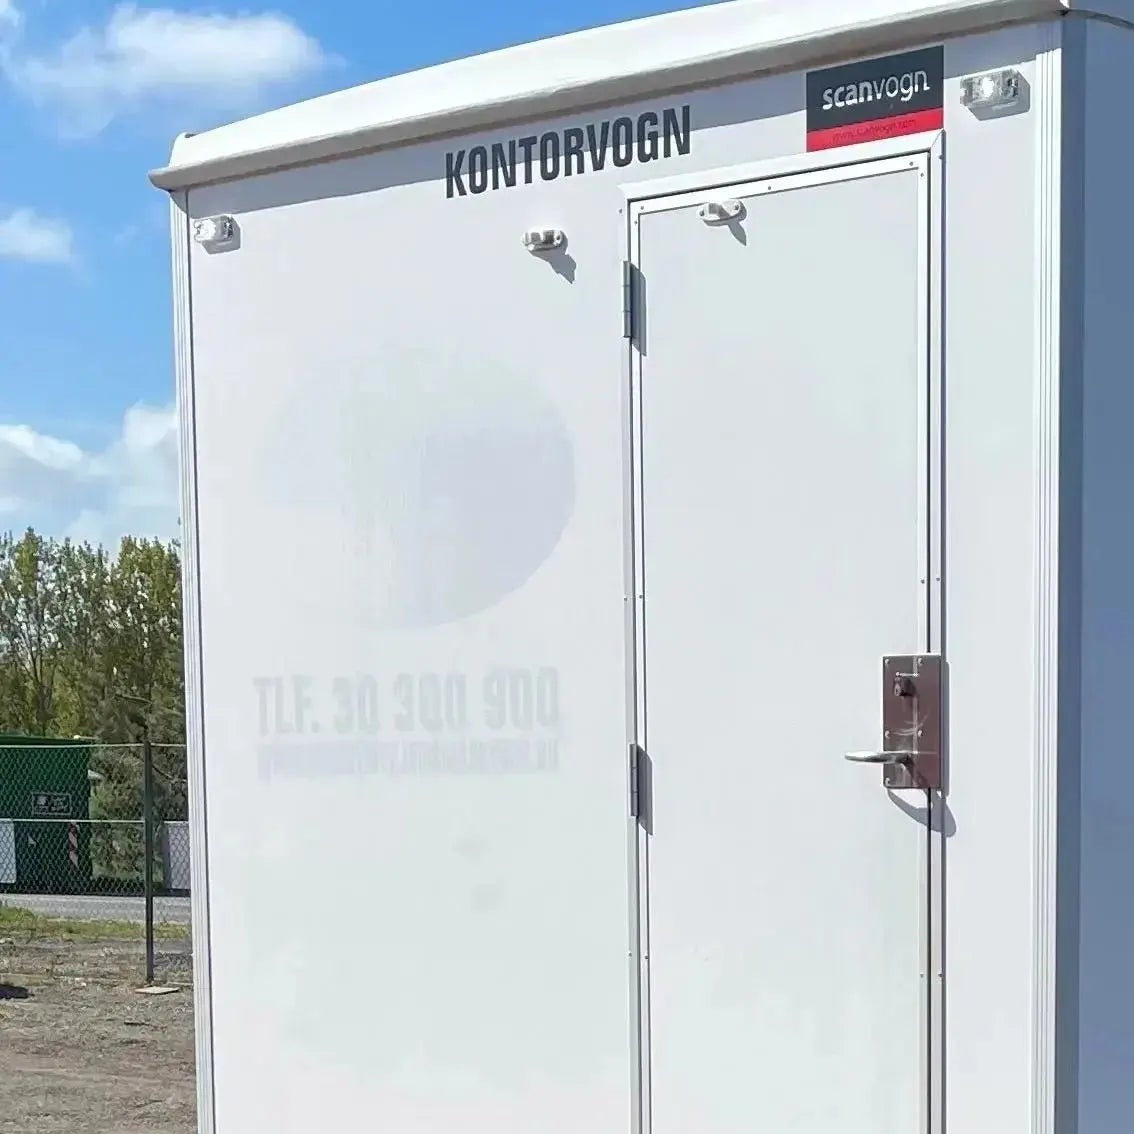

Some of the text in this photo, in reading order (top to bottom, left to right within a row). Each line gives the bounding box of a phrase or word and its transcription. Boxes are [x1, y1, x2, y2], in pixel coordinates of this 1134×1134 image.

[822, 70, 930, 110] scanvogn
[446, 105, 690, 199] KONTORVOGN
[253, 673, 320, 737] TLF.
[394, 672, 467, 732] 300
[483, 665, 559, 730] 900
